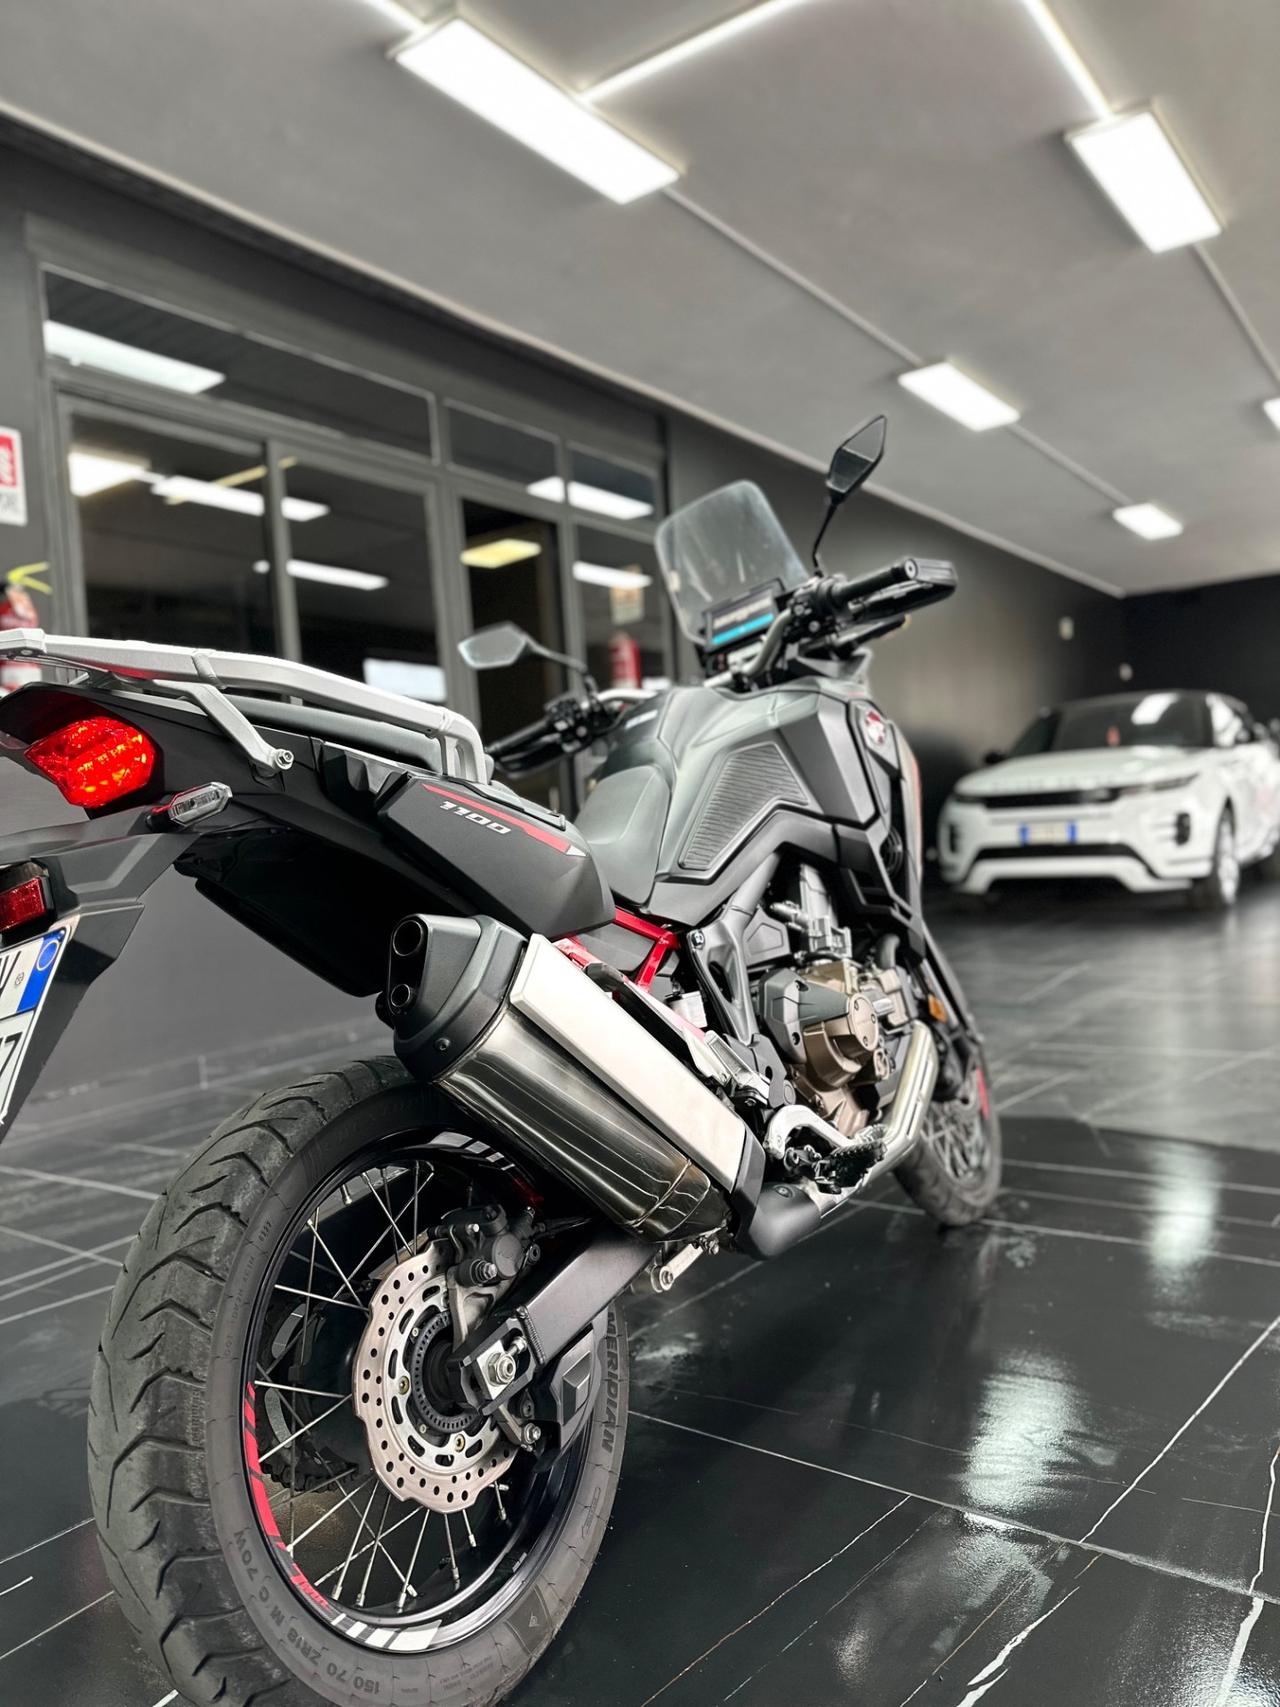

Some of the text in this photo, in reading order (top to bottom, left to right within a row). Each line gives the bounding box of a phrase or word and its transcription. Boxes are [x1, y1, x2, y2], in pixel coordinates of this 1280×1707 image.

[440, 801, 512, 834] 1100
[601, 1311, 619, 1454] MERIDIAN
[326, 1662, 347, 1682] 70
